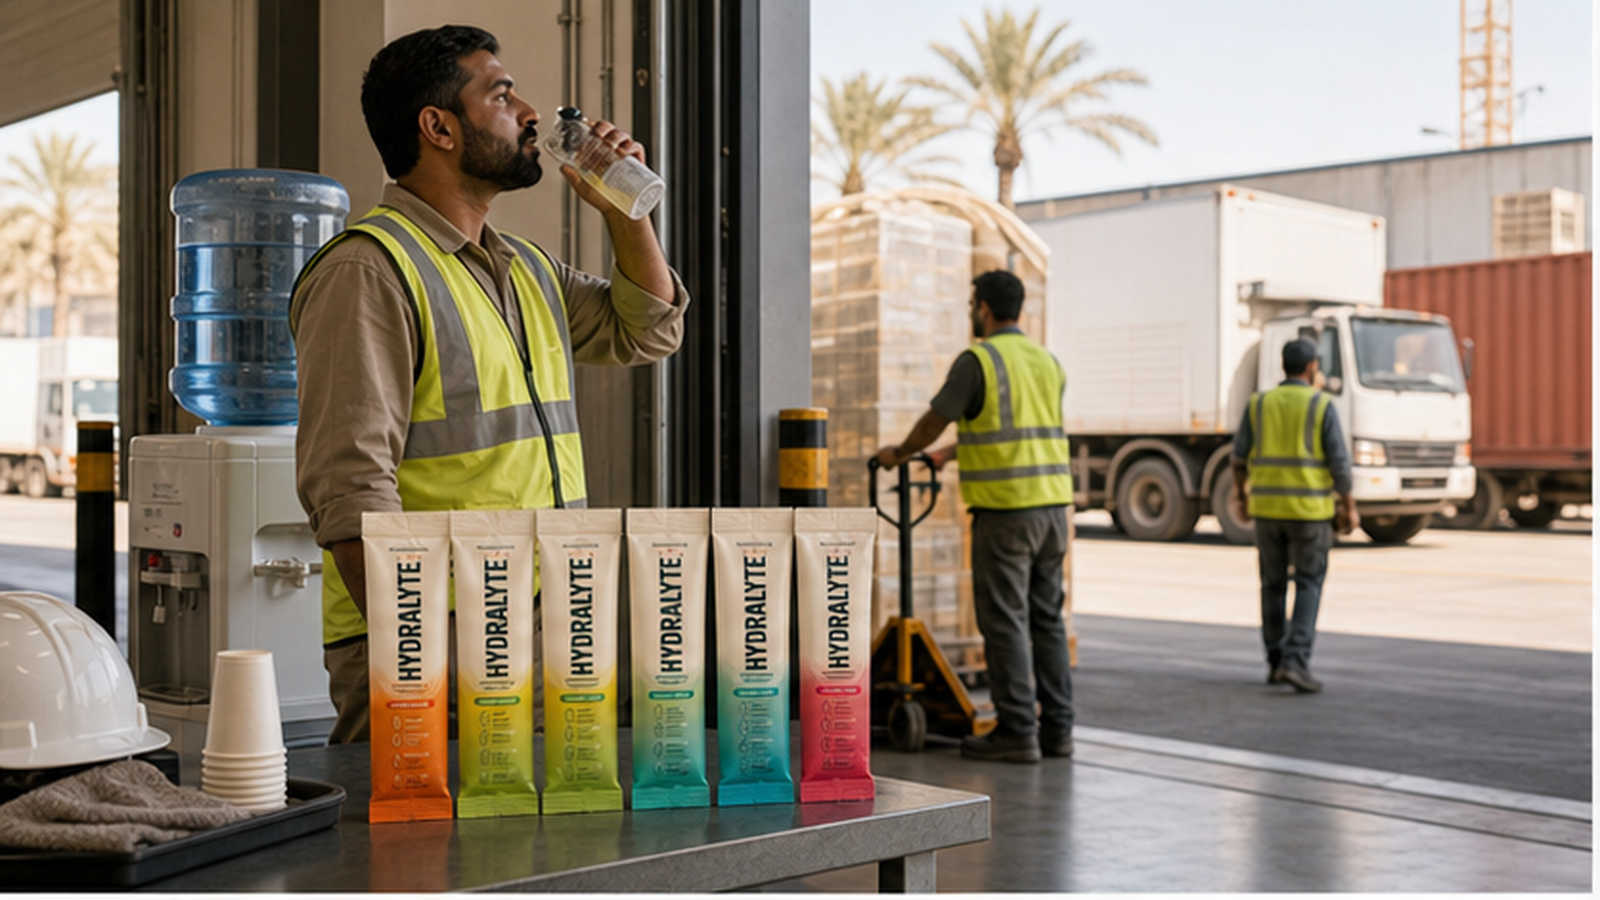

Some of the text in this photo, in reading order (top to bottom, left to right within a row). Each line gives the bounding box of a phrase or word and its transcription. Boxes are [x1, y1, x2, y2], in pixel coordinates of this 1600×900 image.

[397, 561, 422, 681] HYDRALYTE
[484, 559, 509, 678] HYDRALYTE
[569, 557, 594, 675] HYDRALYTE
[659, 557, 683, 672] HYDRALYTE
[744, 556, 768, 671] HYDRALYTE
[827, 555, 850, 668] HYDRALYTE
